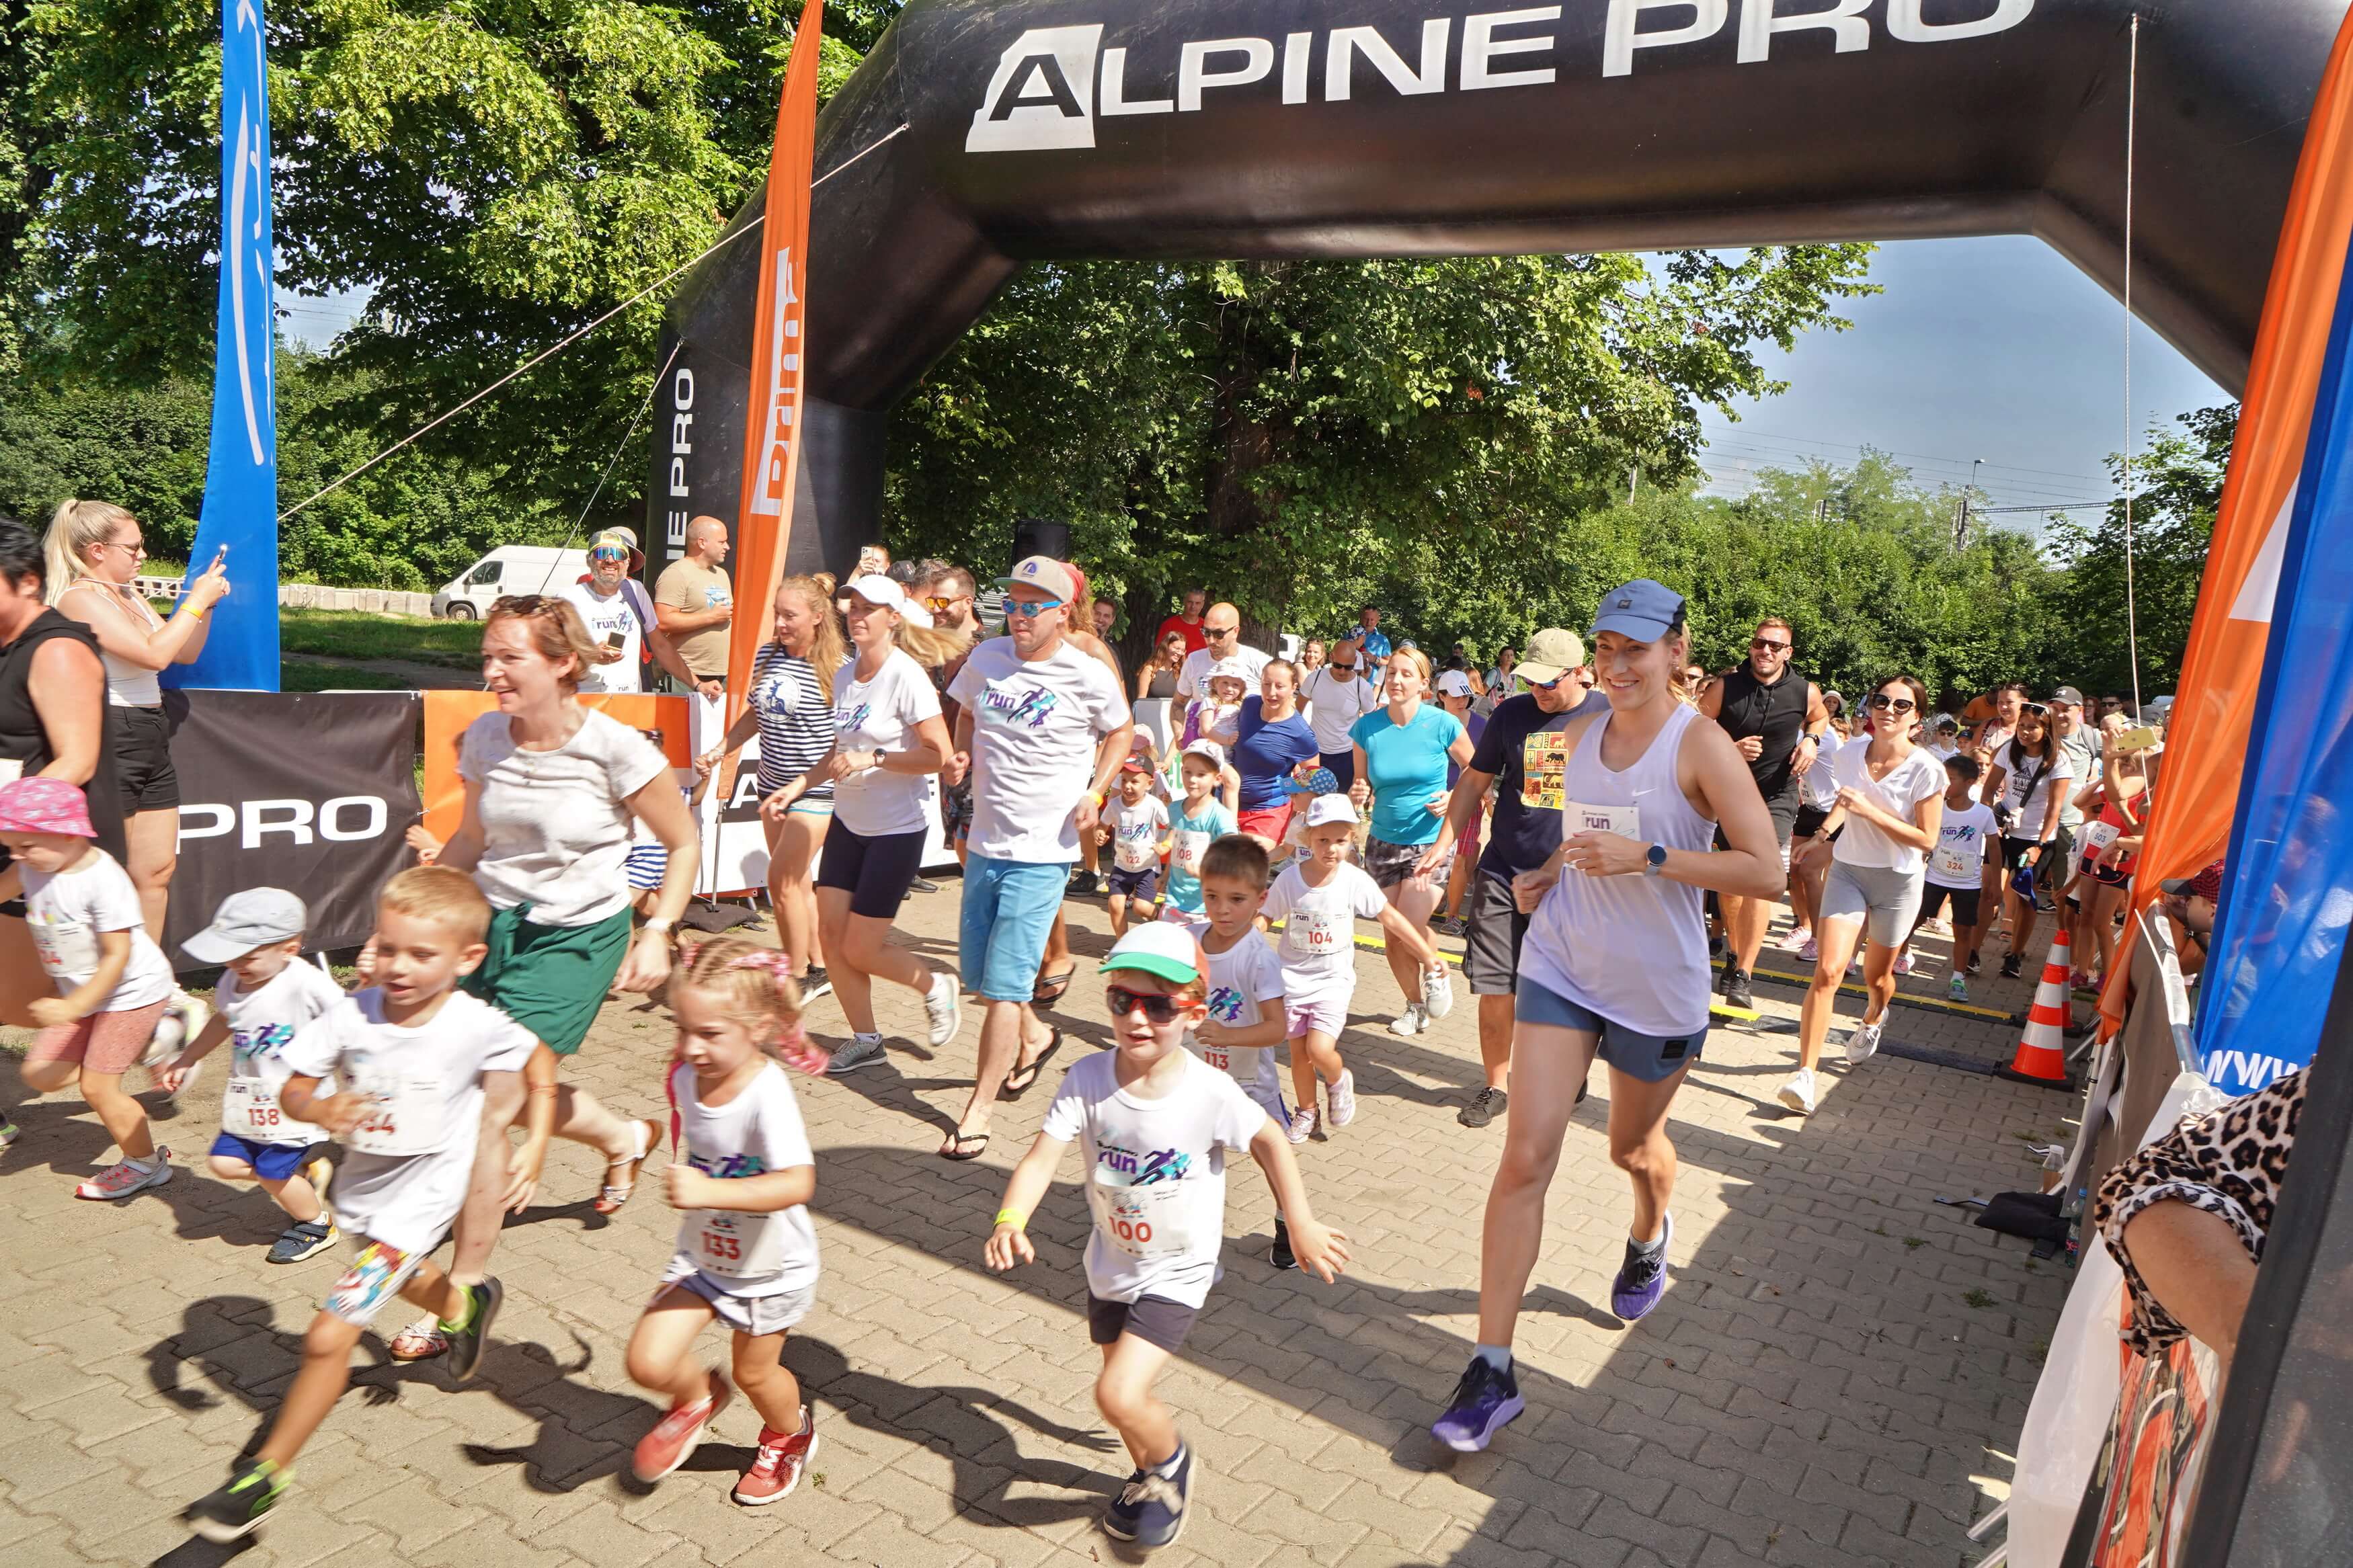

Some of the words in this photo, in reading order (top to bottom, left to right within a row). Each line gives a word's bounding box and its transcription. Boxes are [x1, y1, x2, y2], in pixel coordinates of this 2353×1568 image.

[966, 5, 1562, 152] ALPINE
[670, 368, 694, 497] PRO
[175, 796, 387, 854] PRO
[1946, 860, 1964, 871] 324
[1308, 931, 1332, 945] 104
[1204, 1050, 1229, 1071] 113
[247, 1108, 280, 1126] 138
[1098, 1150, 1137, 1175] run
[1109, 1215, 1152, 1243] 100
[703, 1231, 742, 1260] 133
